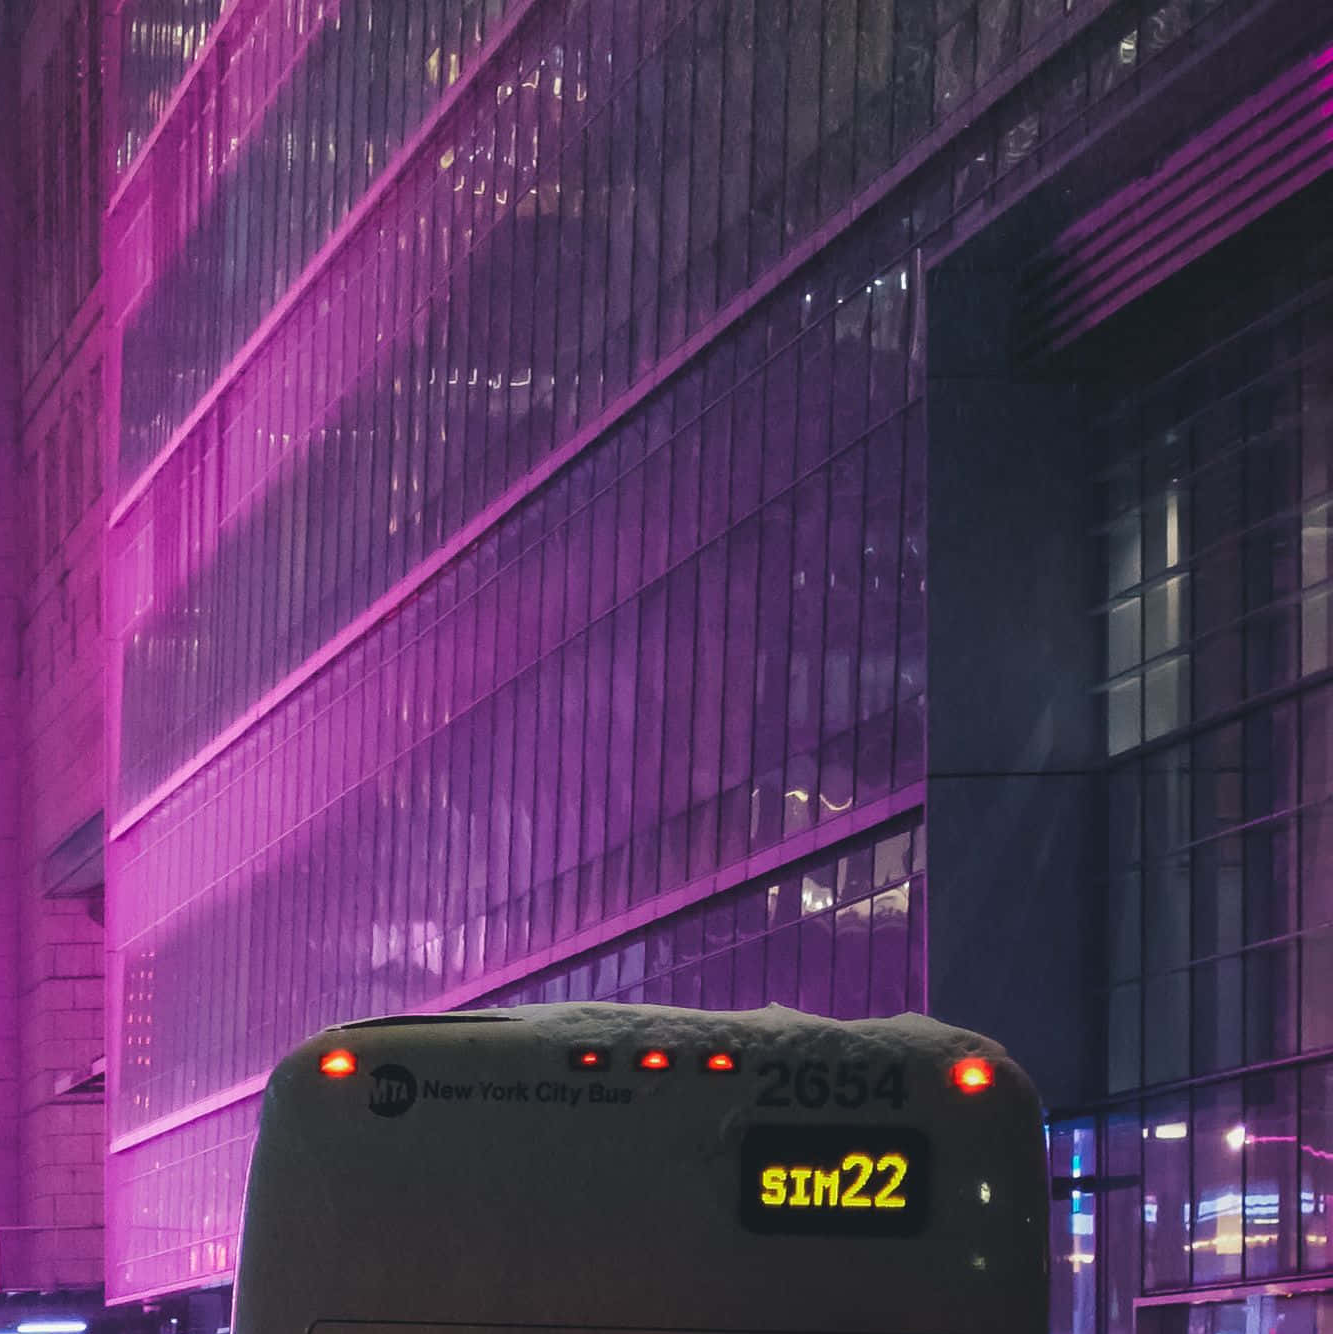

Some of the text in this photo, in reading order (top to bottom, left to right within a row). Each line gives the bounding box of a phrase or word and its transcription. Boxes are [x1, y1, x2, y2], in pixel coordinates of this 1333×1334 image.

[422, 1080, 633, 1106] New York City Bus
[755, 1060, 910, 1110] 2654
[760, 1154, 909, 1208] SIM22
